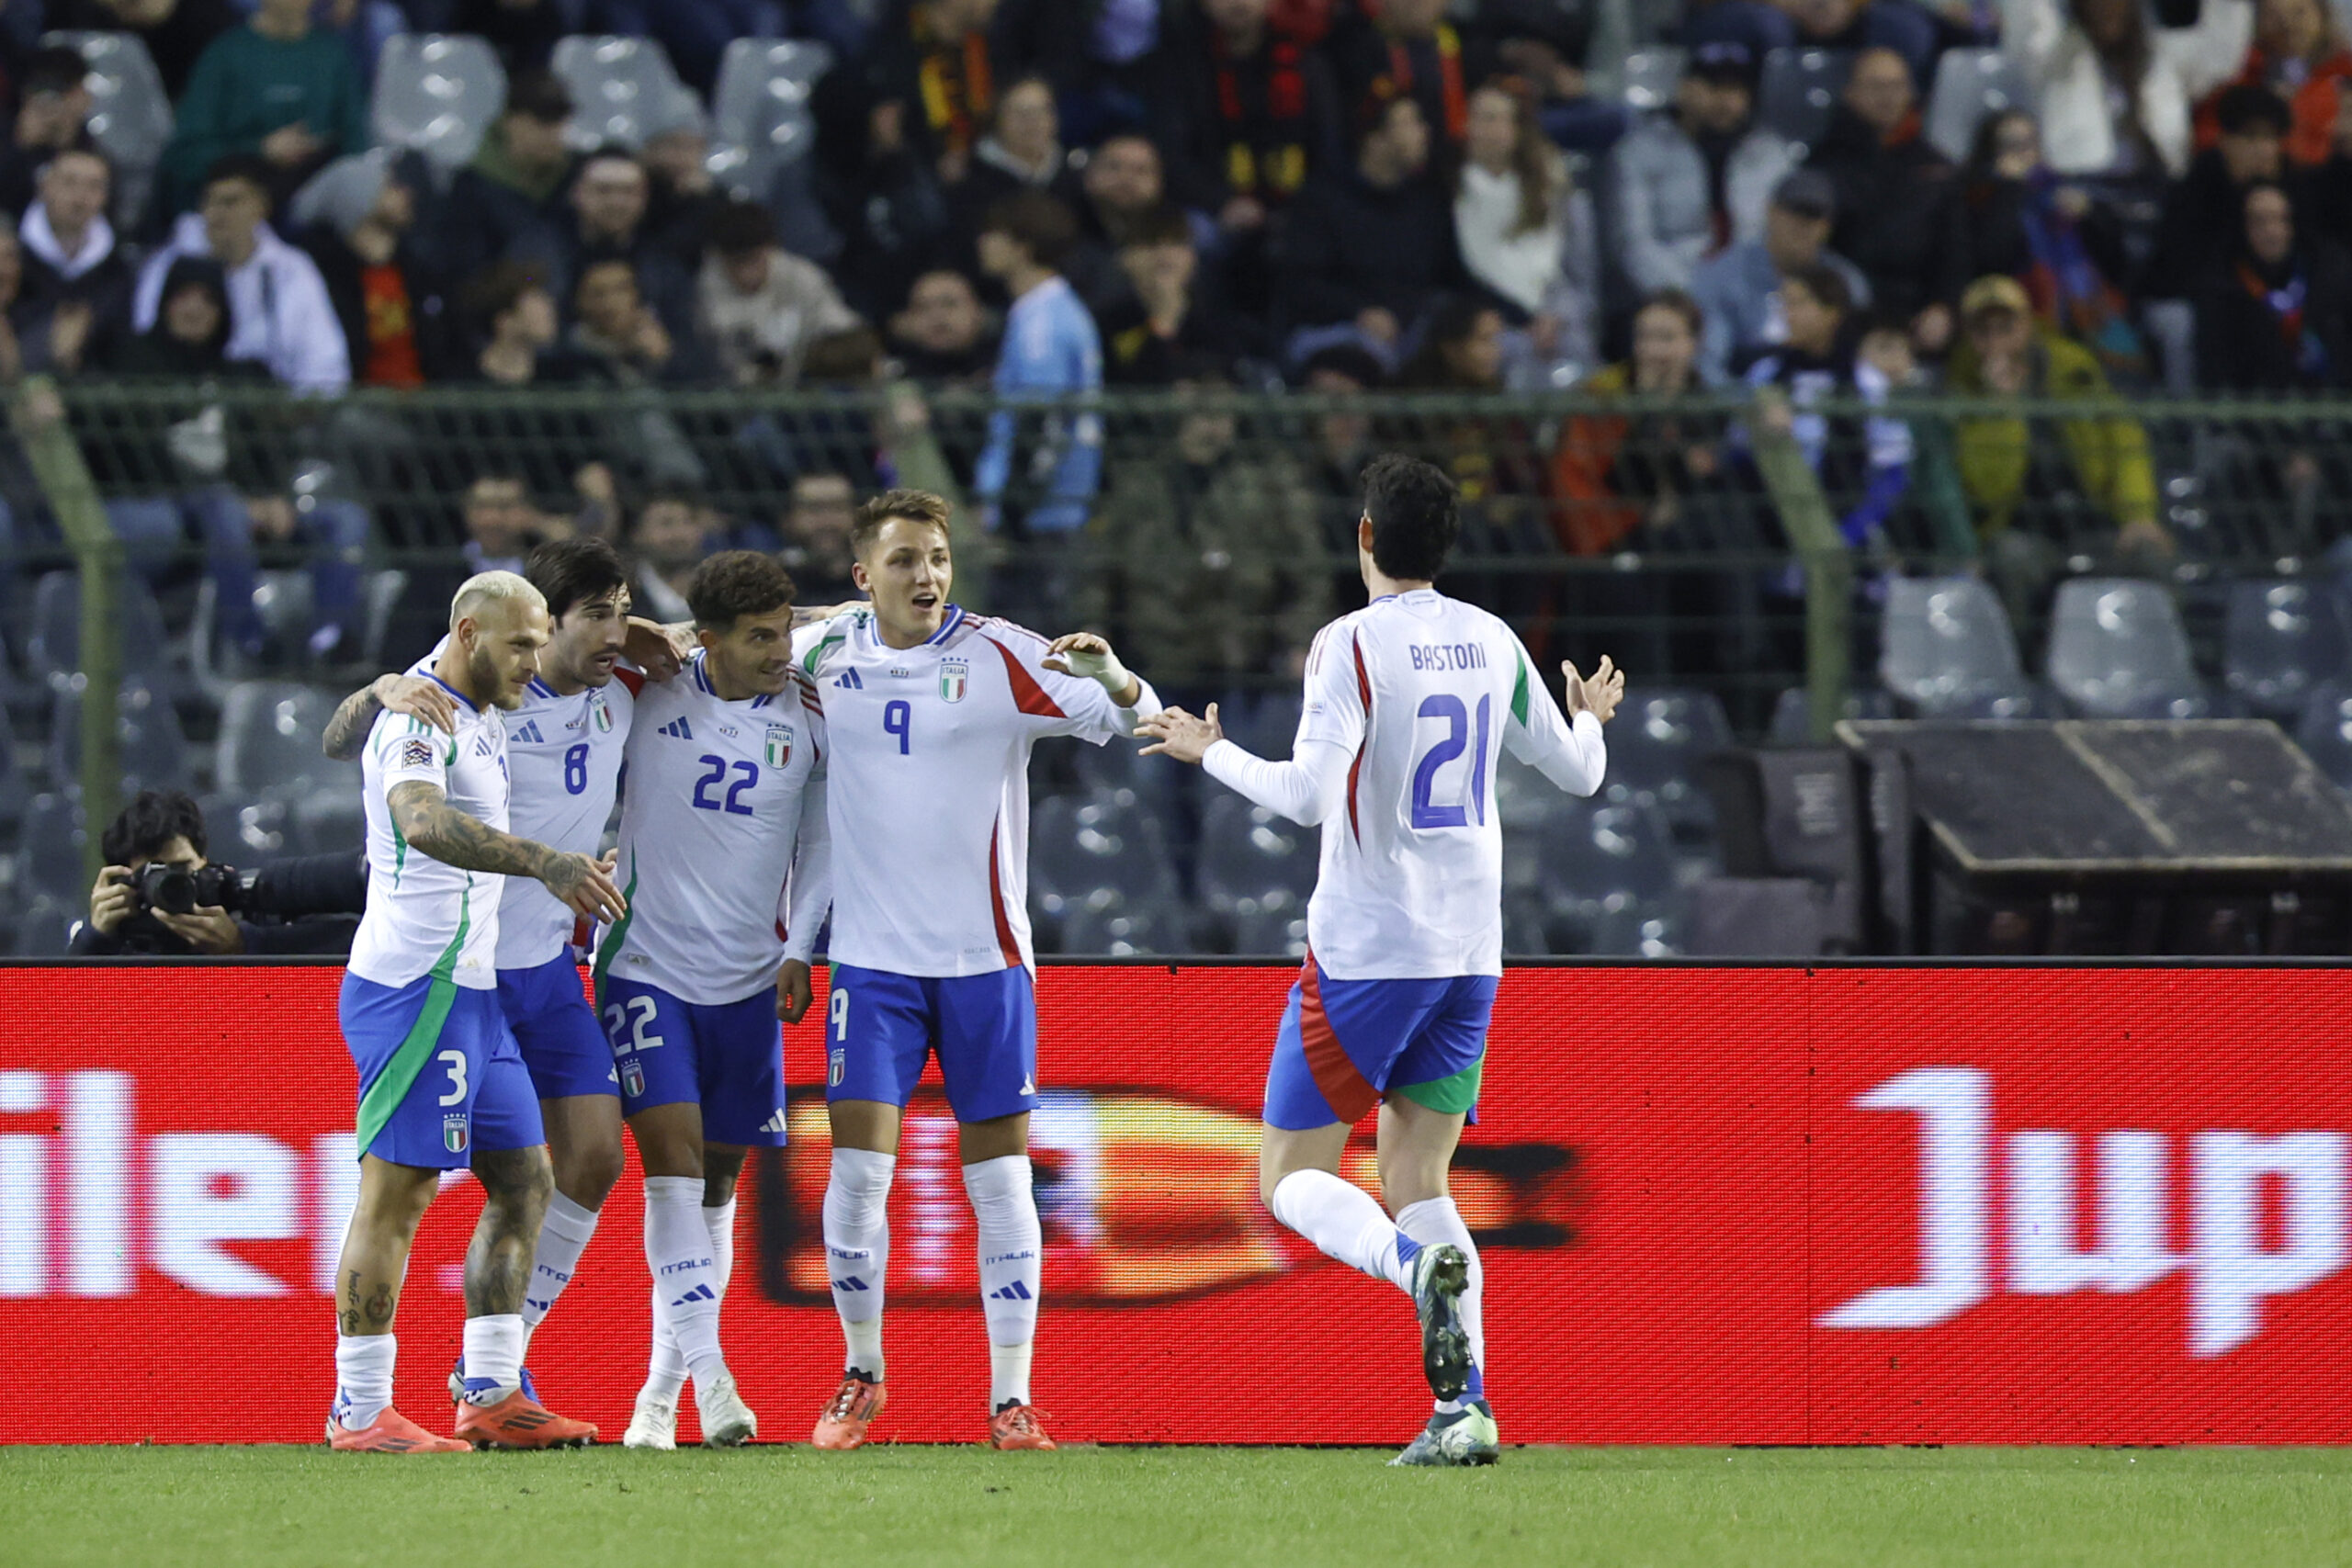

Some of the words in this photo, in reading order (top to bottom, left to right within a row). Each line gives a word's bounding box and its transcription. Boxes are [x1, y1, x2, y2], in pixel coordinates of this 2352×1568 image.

[943, 666, 966, 675] ITALIA
[1409, 642, 1487, 671] BASTONI
[767, 731, 791, 741] ITALIA
[884, 700, 910, 755] 9
[564, 743, 589, 795] 8
[693, 754, 759, 816] 22
[1411, 693, 1490, 829] 21
[604, 995, 664, 1057] 22
[831, 987, 849, 1042] 9
[436, 1049, 468, 1107] 3
[1810, 1065, 2352, 1359] Jup
[537, 1263, 570, 1283] ITA
[660, 1258, 712, 1276] ITALIA
